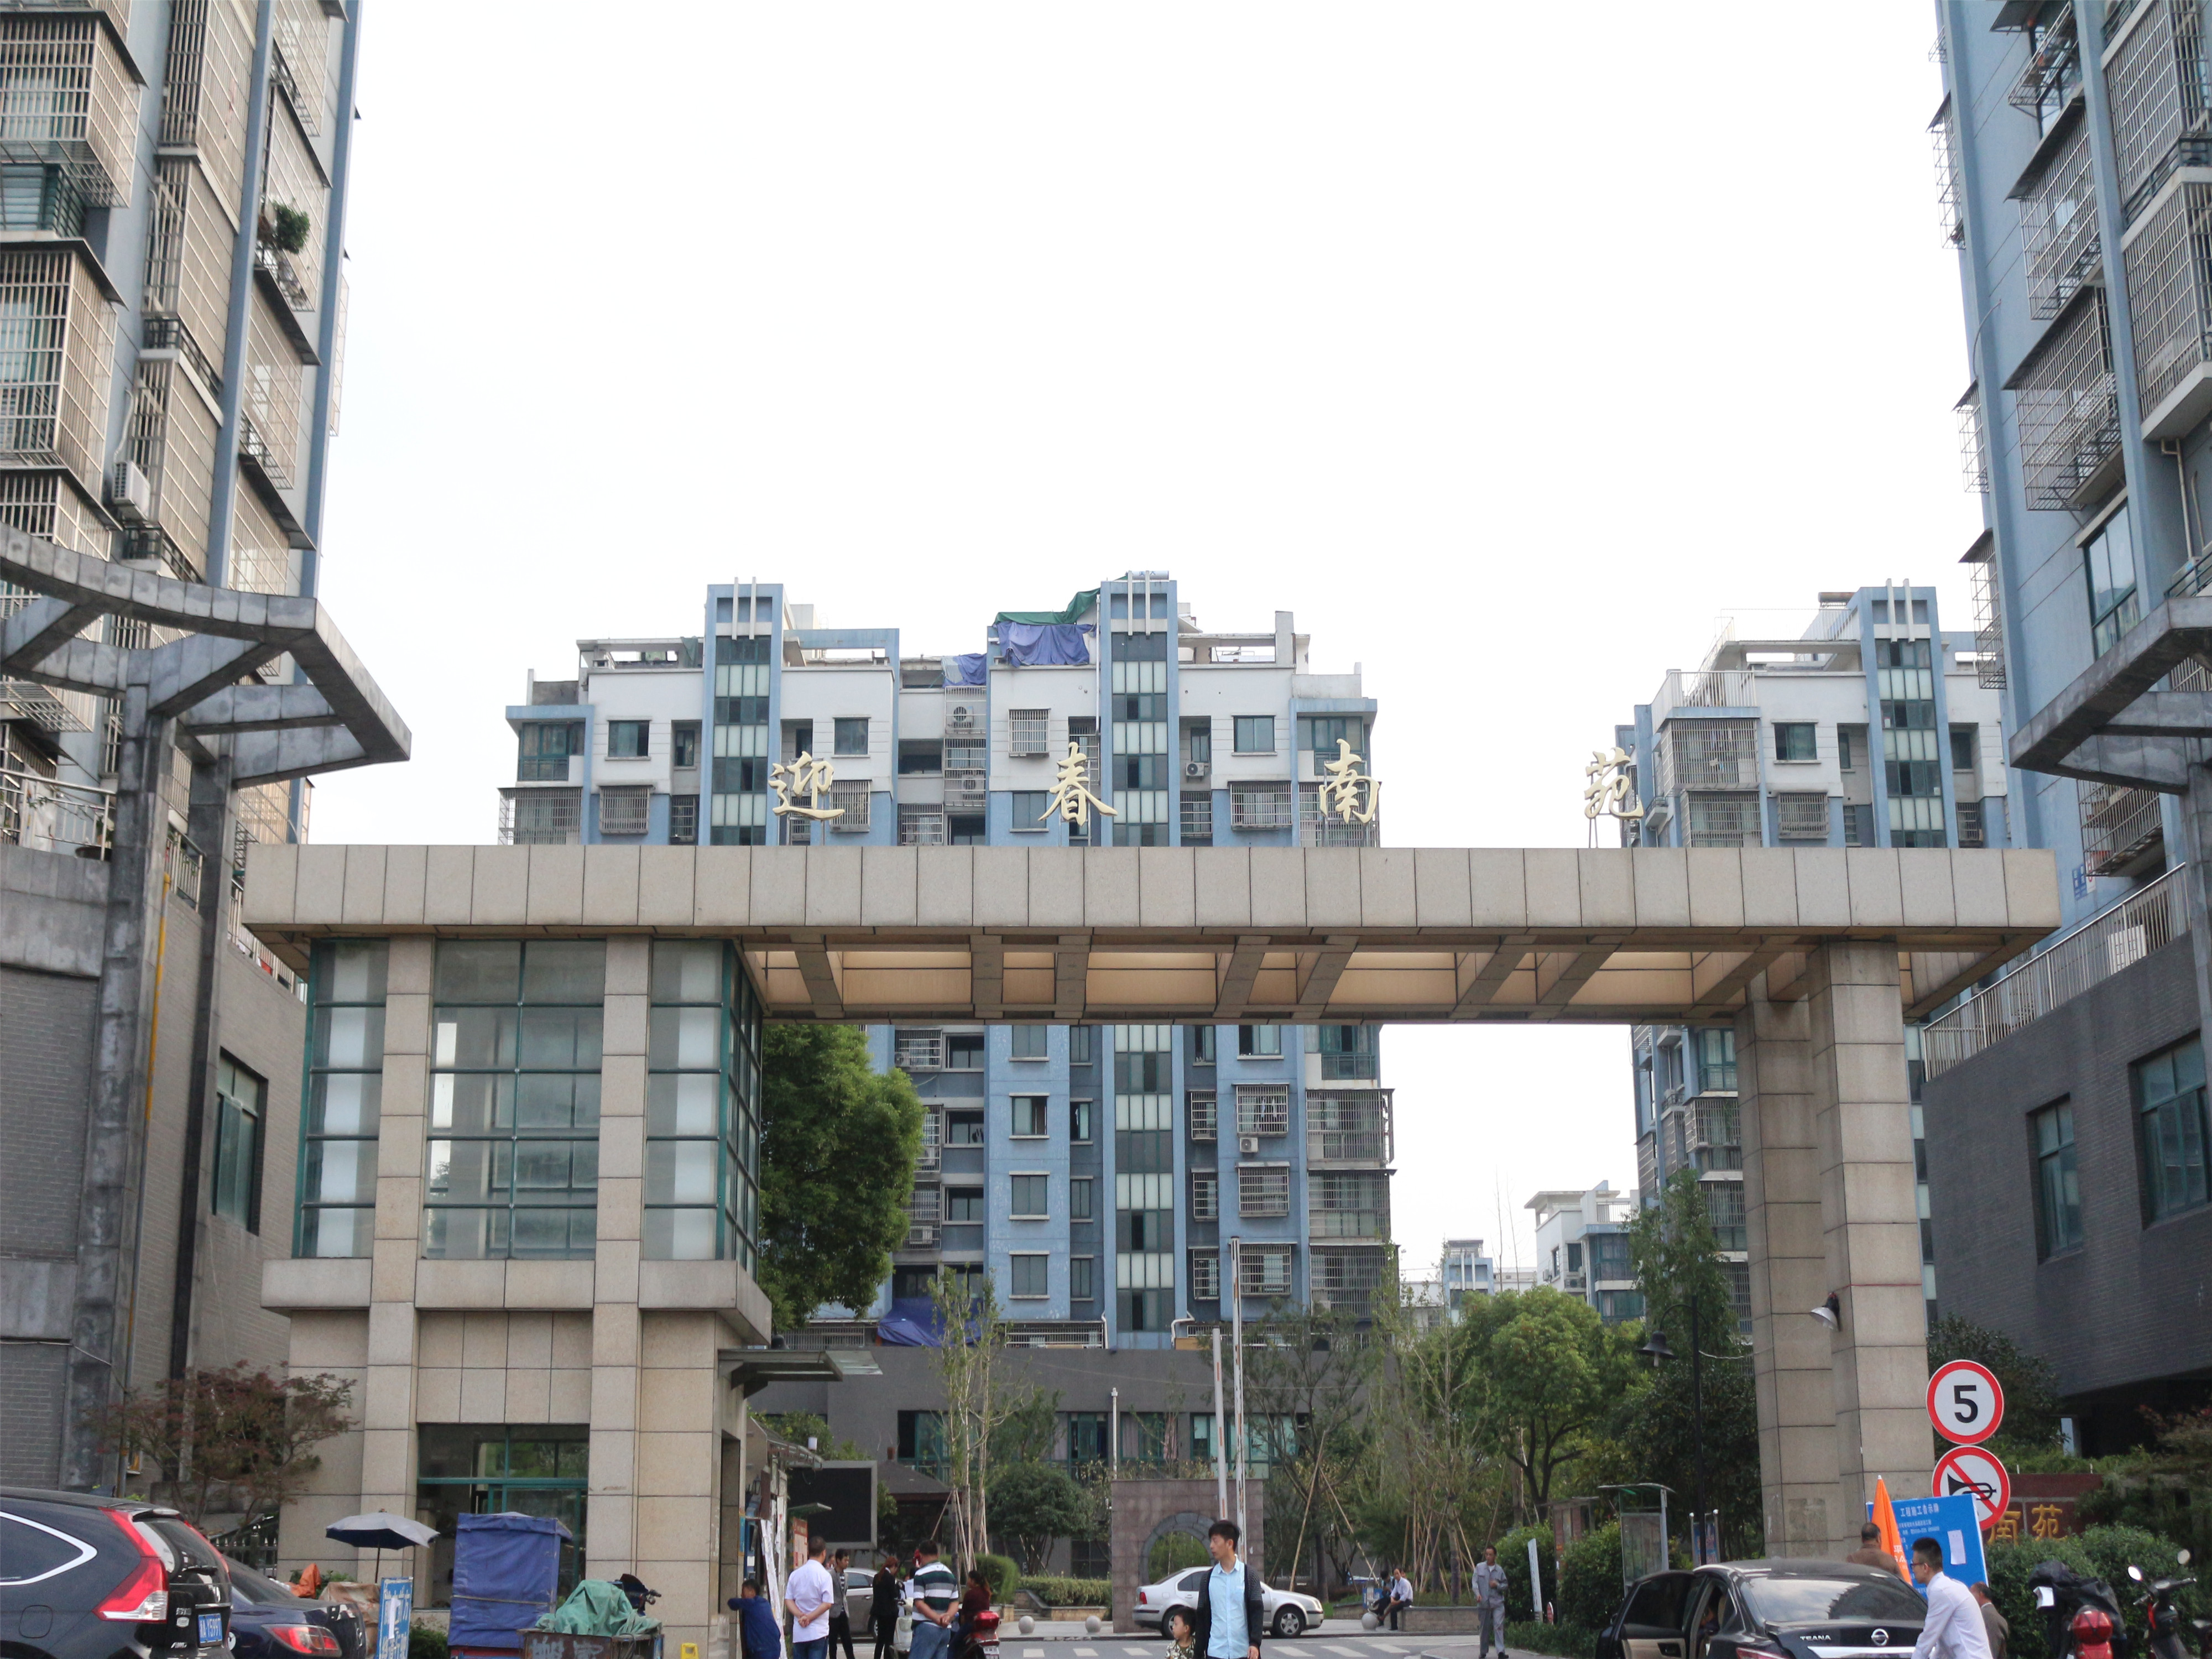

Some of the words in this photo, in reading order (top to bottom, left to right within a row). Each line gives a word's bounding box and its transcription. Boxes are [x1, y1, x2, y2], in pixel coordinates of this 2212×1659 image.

[768, 741, 1644, 826] 迎春南苑
[1954, 1385, 1978, 1423] 5
